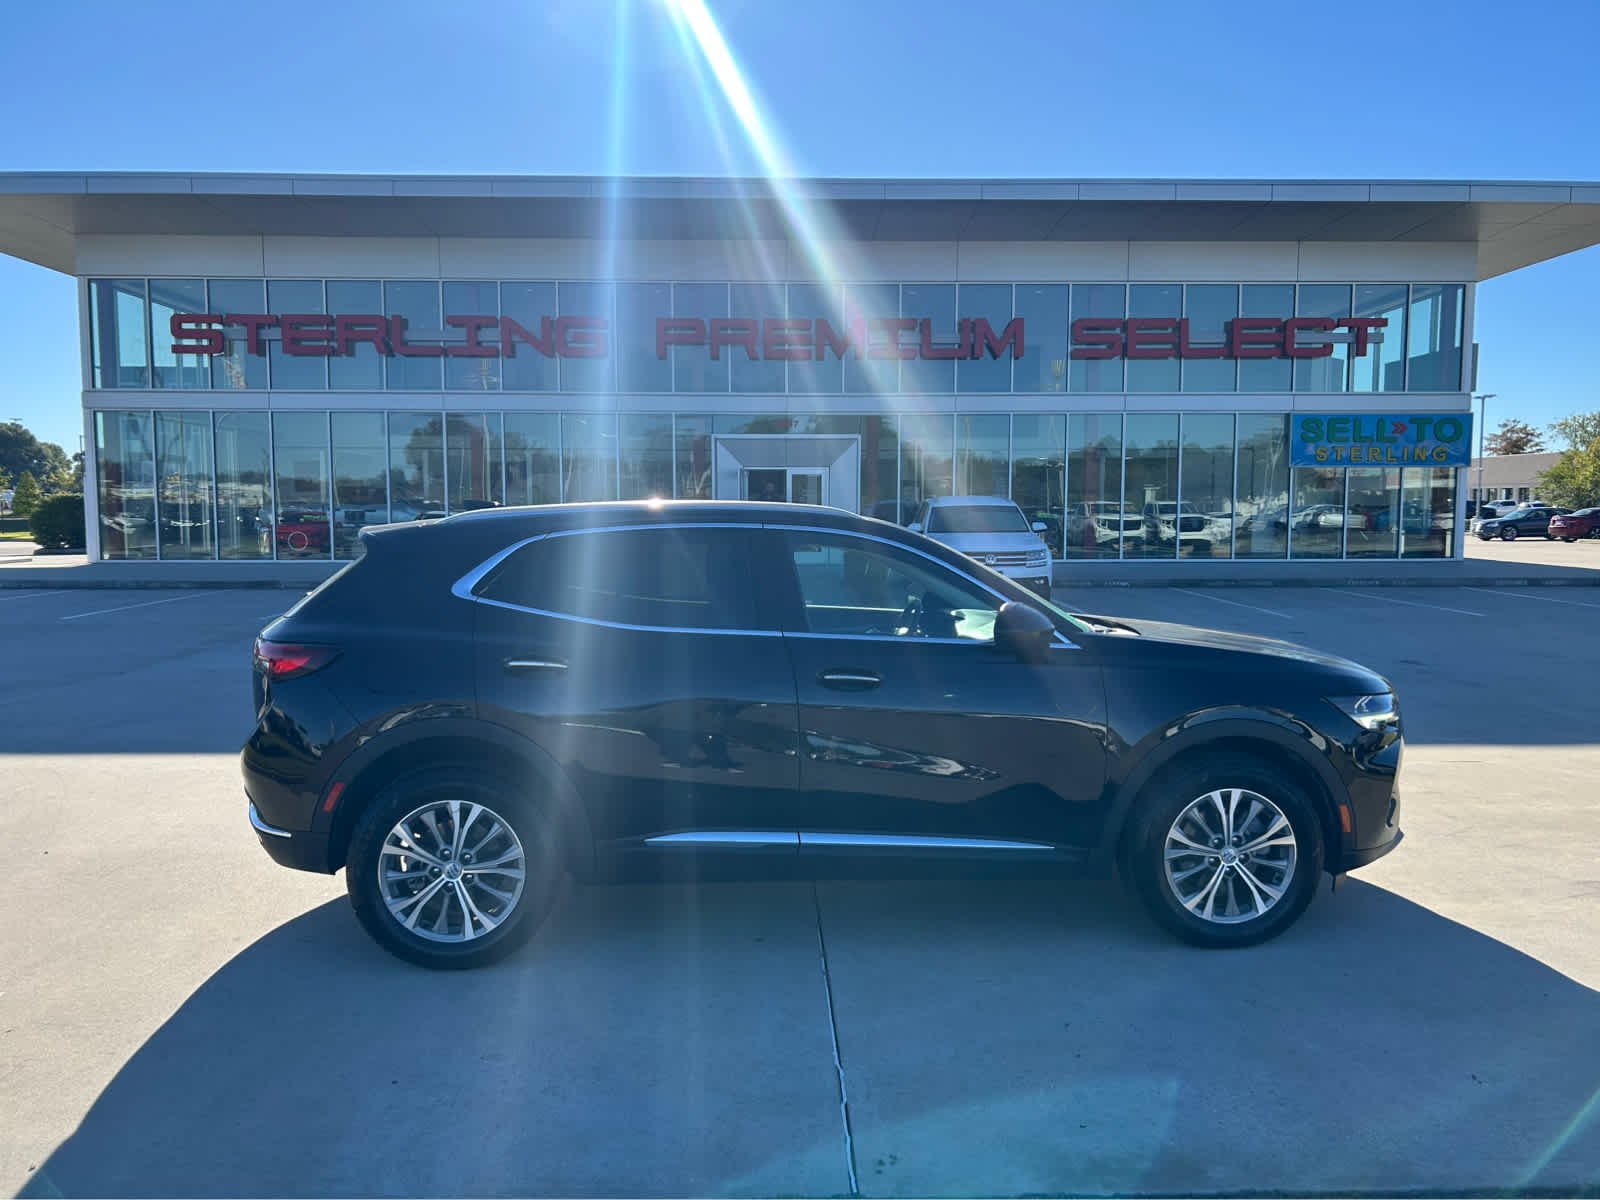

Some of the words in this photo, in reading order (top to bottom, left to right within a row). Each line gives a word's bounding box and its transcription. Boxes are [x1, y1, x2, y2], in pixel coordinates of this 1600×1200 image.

[171, 313, 609, 358] STERLING
[656, 317, 1025, 361] PREMIUM
[1071, 317, 1388, 360] SELECT
[1300, 417, 1397, 443] SELL
[1408, 417, 1464, 443] TO
[1315, 446, 1448, 462] STERLING
